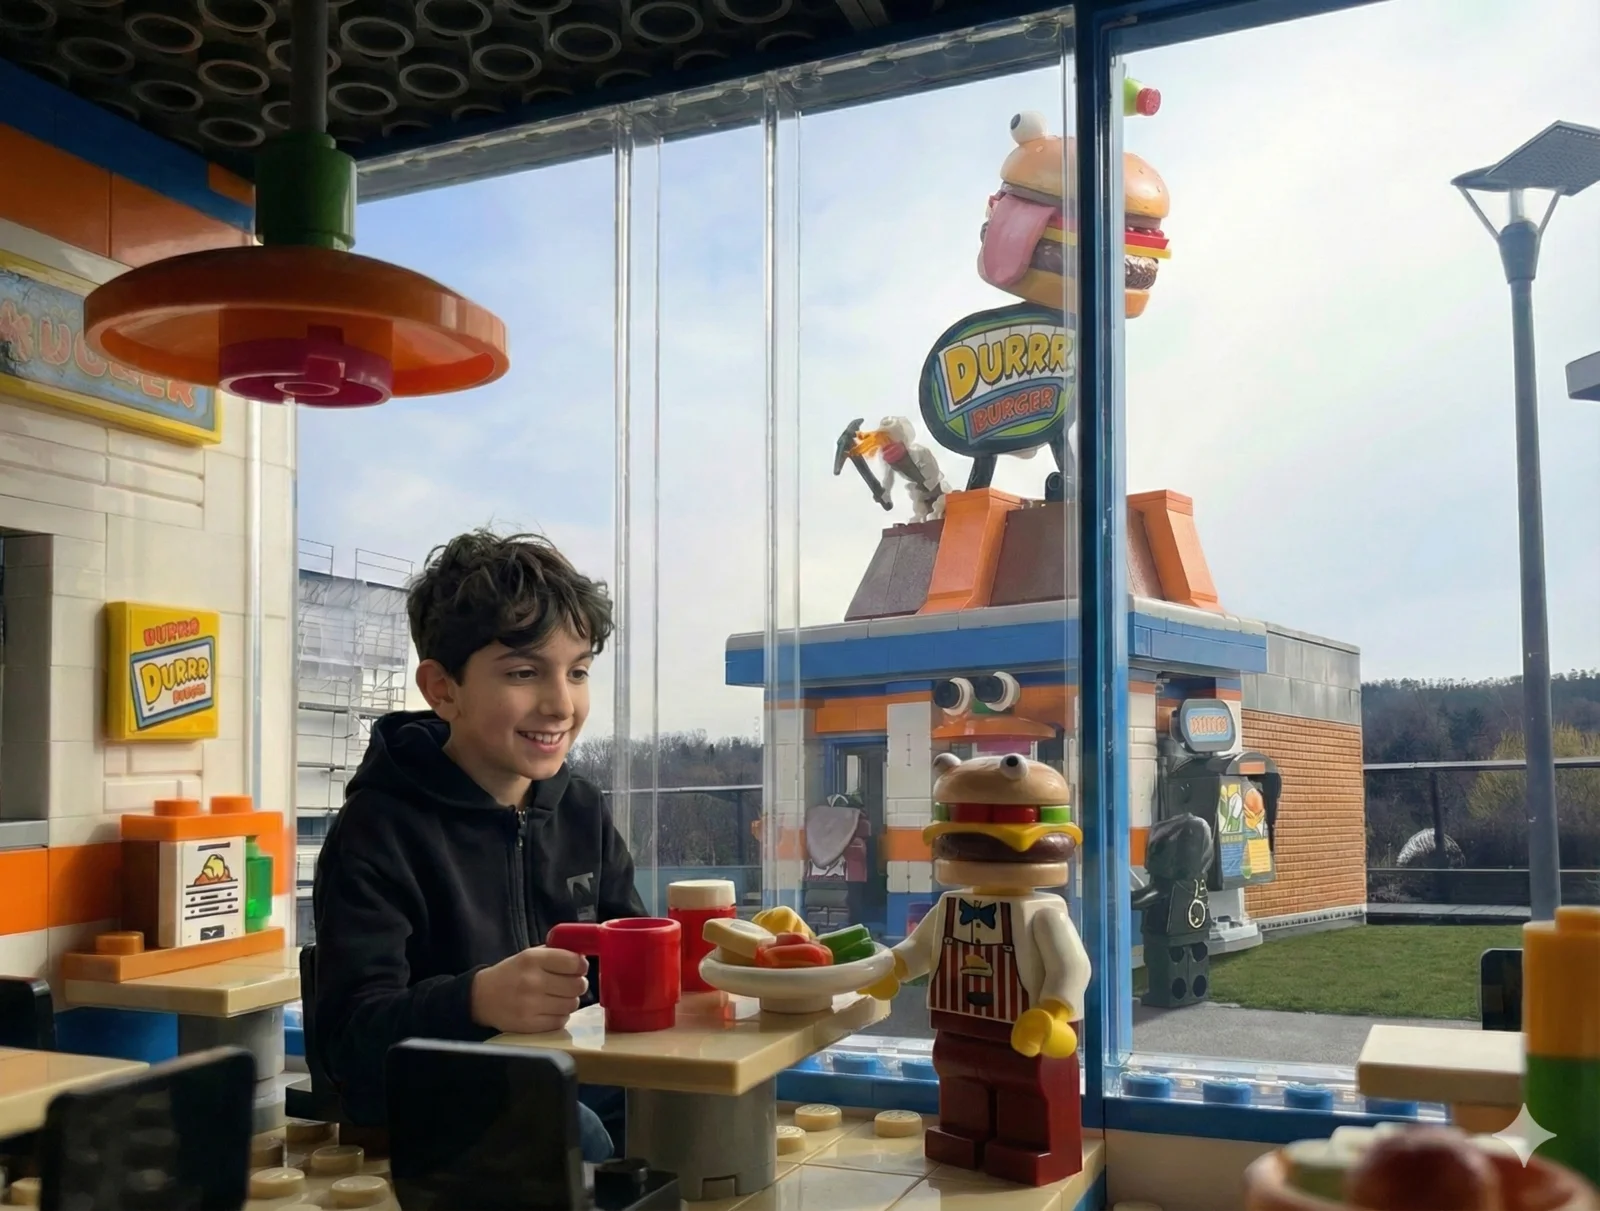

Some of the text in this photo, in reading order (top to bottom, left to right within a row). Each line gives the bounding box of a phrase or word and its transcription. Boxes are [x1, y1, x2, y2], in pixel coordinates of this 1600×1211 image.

[944, 332, 1071, 406] DURRR
[971, 387, 1055, 433] BURGER
[140, 657, 209, 706] DURRR
